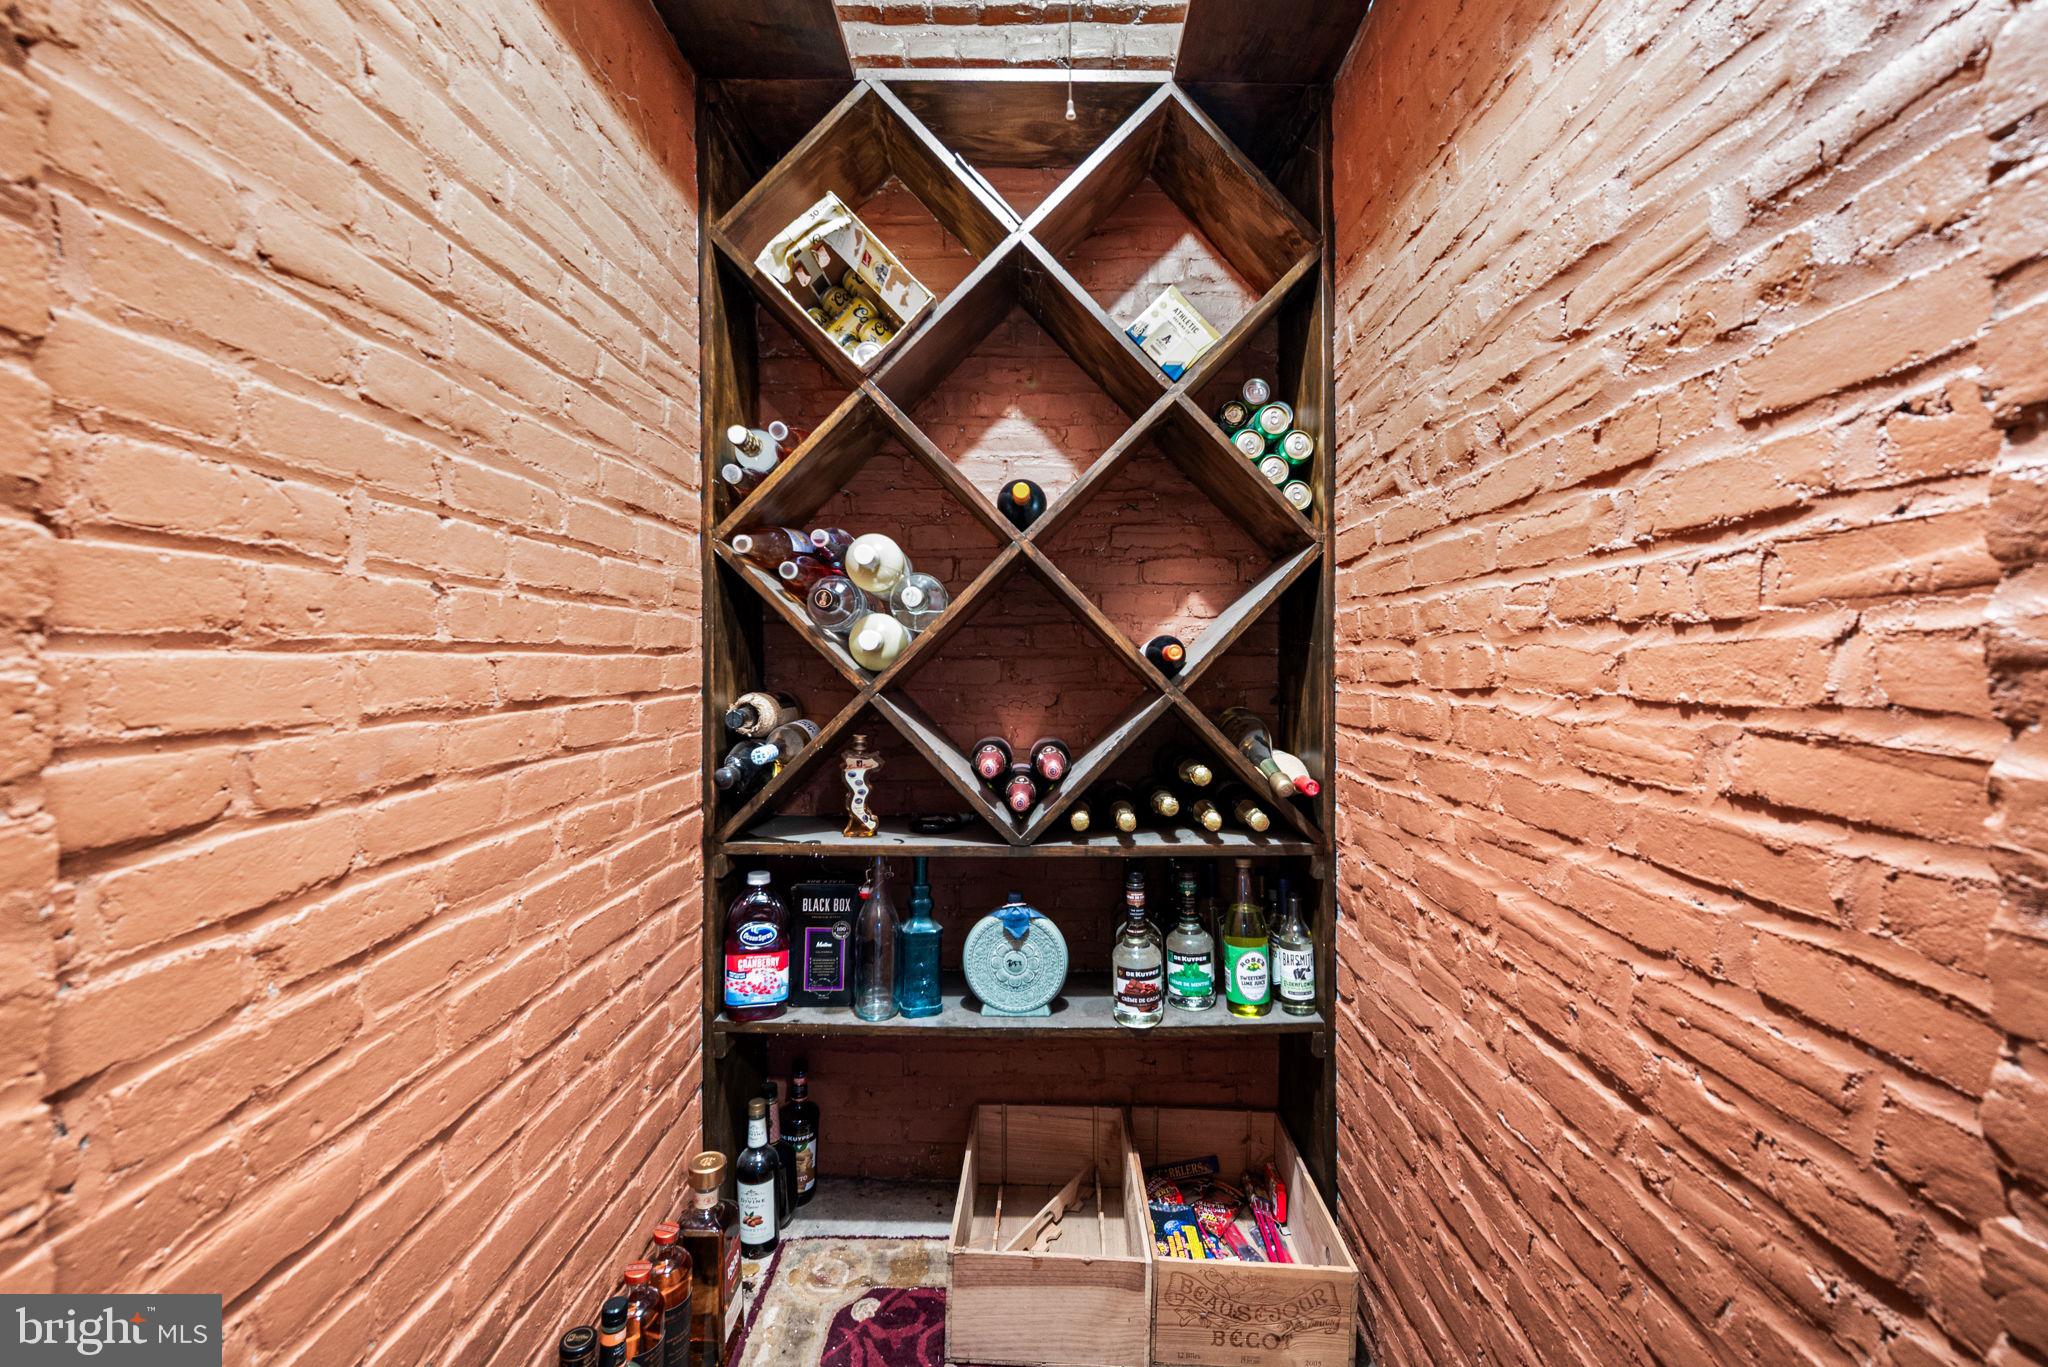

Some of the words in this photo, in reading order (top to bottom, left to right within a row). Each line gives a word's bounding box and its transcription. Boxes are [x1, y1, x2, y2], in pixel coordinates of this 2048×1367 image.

[809, 209, 820, 220] 30
[1172, 307, 1200, 334] ATHLETIC
[802, 897, 830, 912] BLACK
[833, 897, 851, 912] BOX
[742, 932, 759, 941] Ocean
[758, 931, 774, 942] Spray
[737, 956, 780, 970] CRANBERRY
[1240, 957, 1265, 968] ROSE'S
[1135, 968, 1159, 978] KUYPER
[787, 1132, 814, 1142] KUYPER
